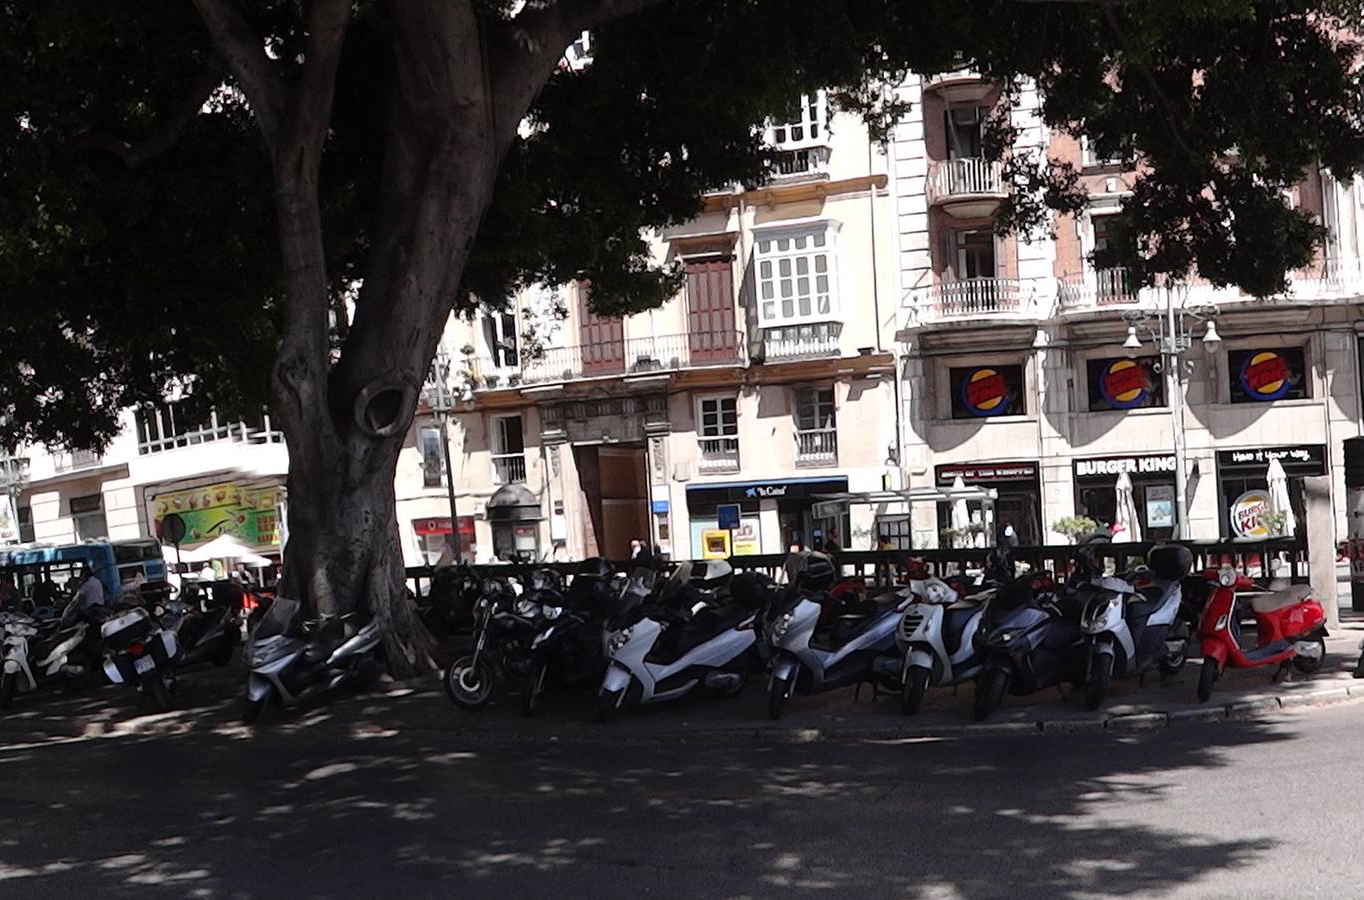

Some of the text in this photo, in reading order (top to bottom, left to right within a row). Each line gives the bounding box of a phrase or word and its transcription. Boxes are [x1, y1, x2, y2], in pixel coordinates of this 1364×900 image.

[1076, 456, 1177, 476] BURGER KING
[1238, 499, 1272, 521] BURG
[1241, 515, 1260, 532] KI
